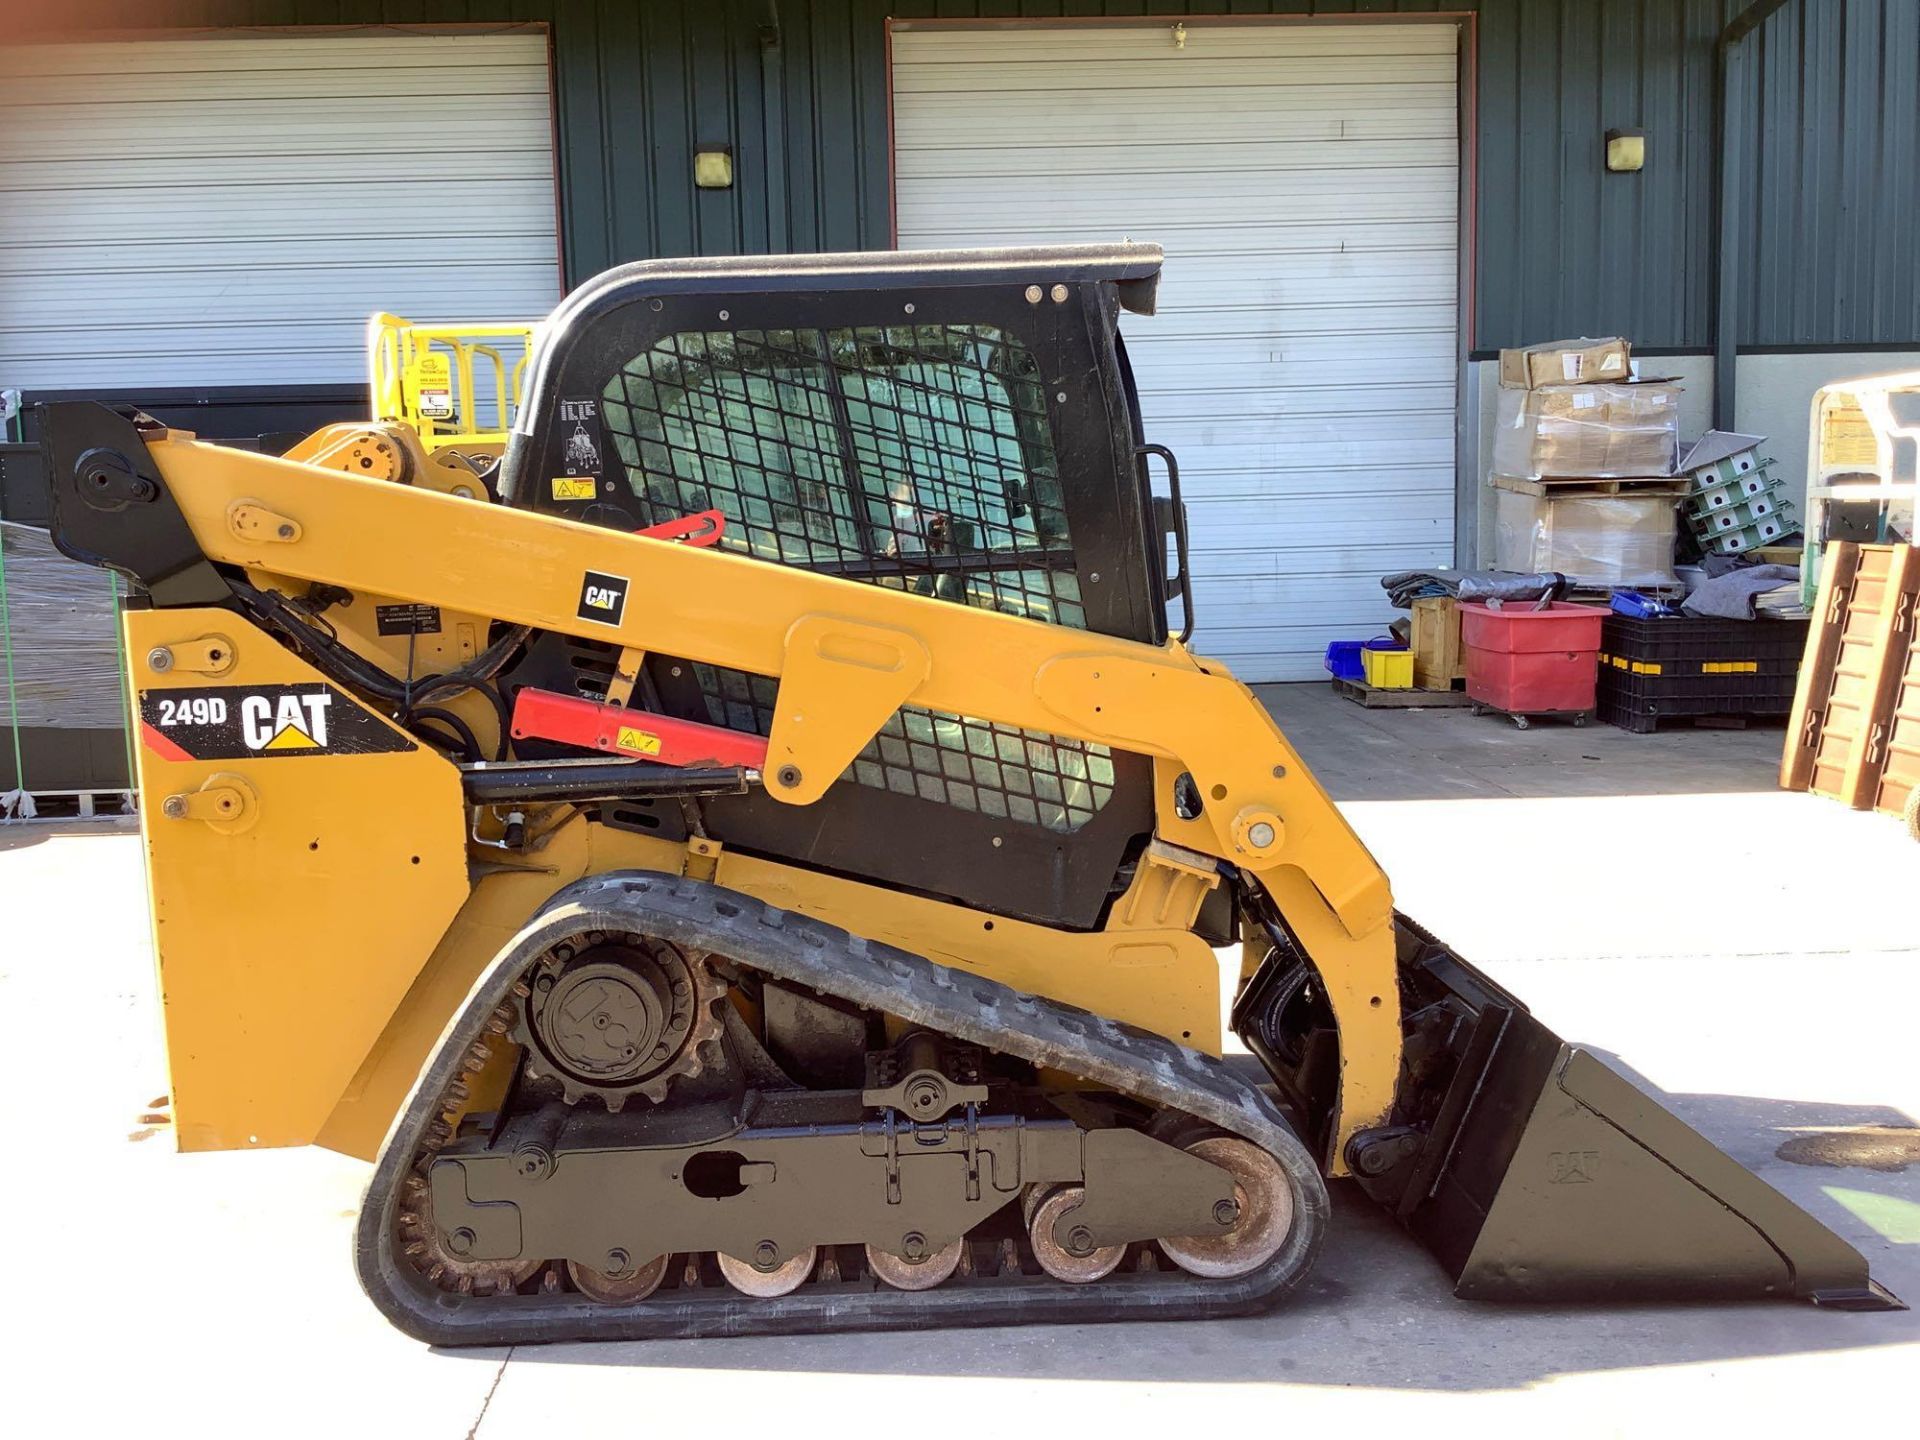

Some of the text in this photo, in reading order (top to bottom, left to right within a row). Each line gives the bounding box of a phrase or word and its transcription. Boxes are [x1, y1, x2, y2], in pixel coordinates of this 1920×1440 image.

[585, 586, 619, 610] CAT
[159, 694, 332, 750] 249D CAT
[1547, 1151, 1600, 1184] CAT
